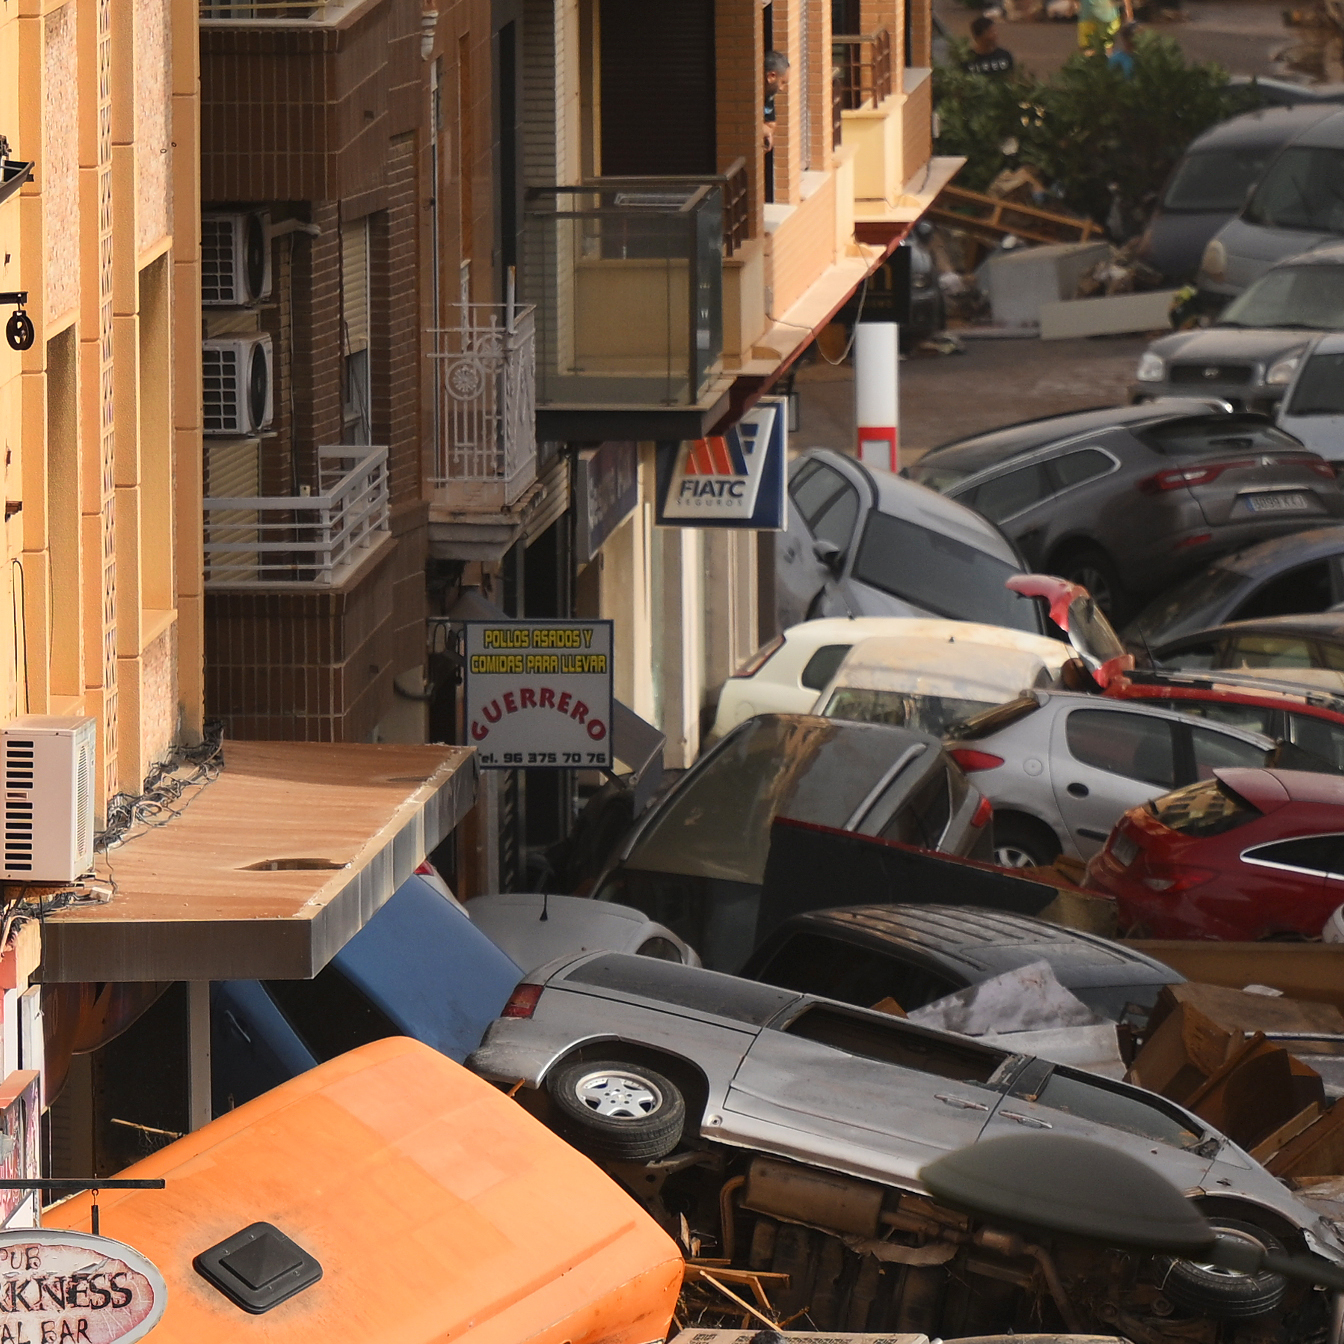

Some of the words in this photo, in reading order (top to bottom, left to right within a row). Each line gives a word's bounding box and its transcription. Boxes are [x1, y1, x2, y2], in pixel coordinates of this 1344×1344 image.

[679, 480, 746, 499] FIATC
[483, 629, 530, 649] POLLOS
[531, 629, 581, 649] ASADOS
[581, 629, 594, 649] Y
[470, 654, 523, 675] COMIDAS
[525, 654, 559, 675] PARA
[560, 654, 608, 675] LLEVAR
[471, 687, 607, 742] GUERRERO
[479, 752, 498, 764] el.
[503, 752, 523, 764] 96
[527, 752, 557, 764] 375
[562, 752, 582, 764] 70
[586, 752, 606, 764] 76
